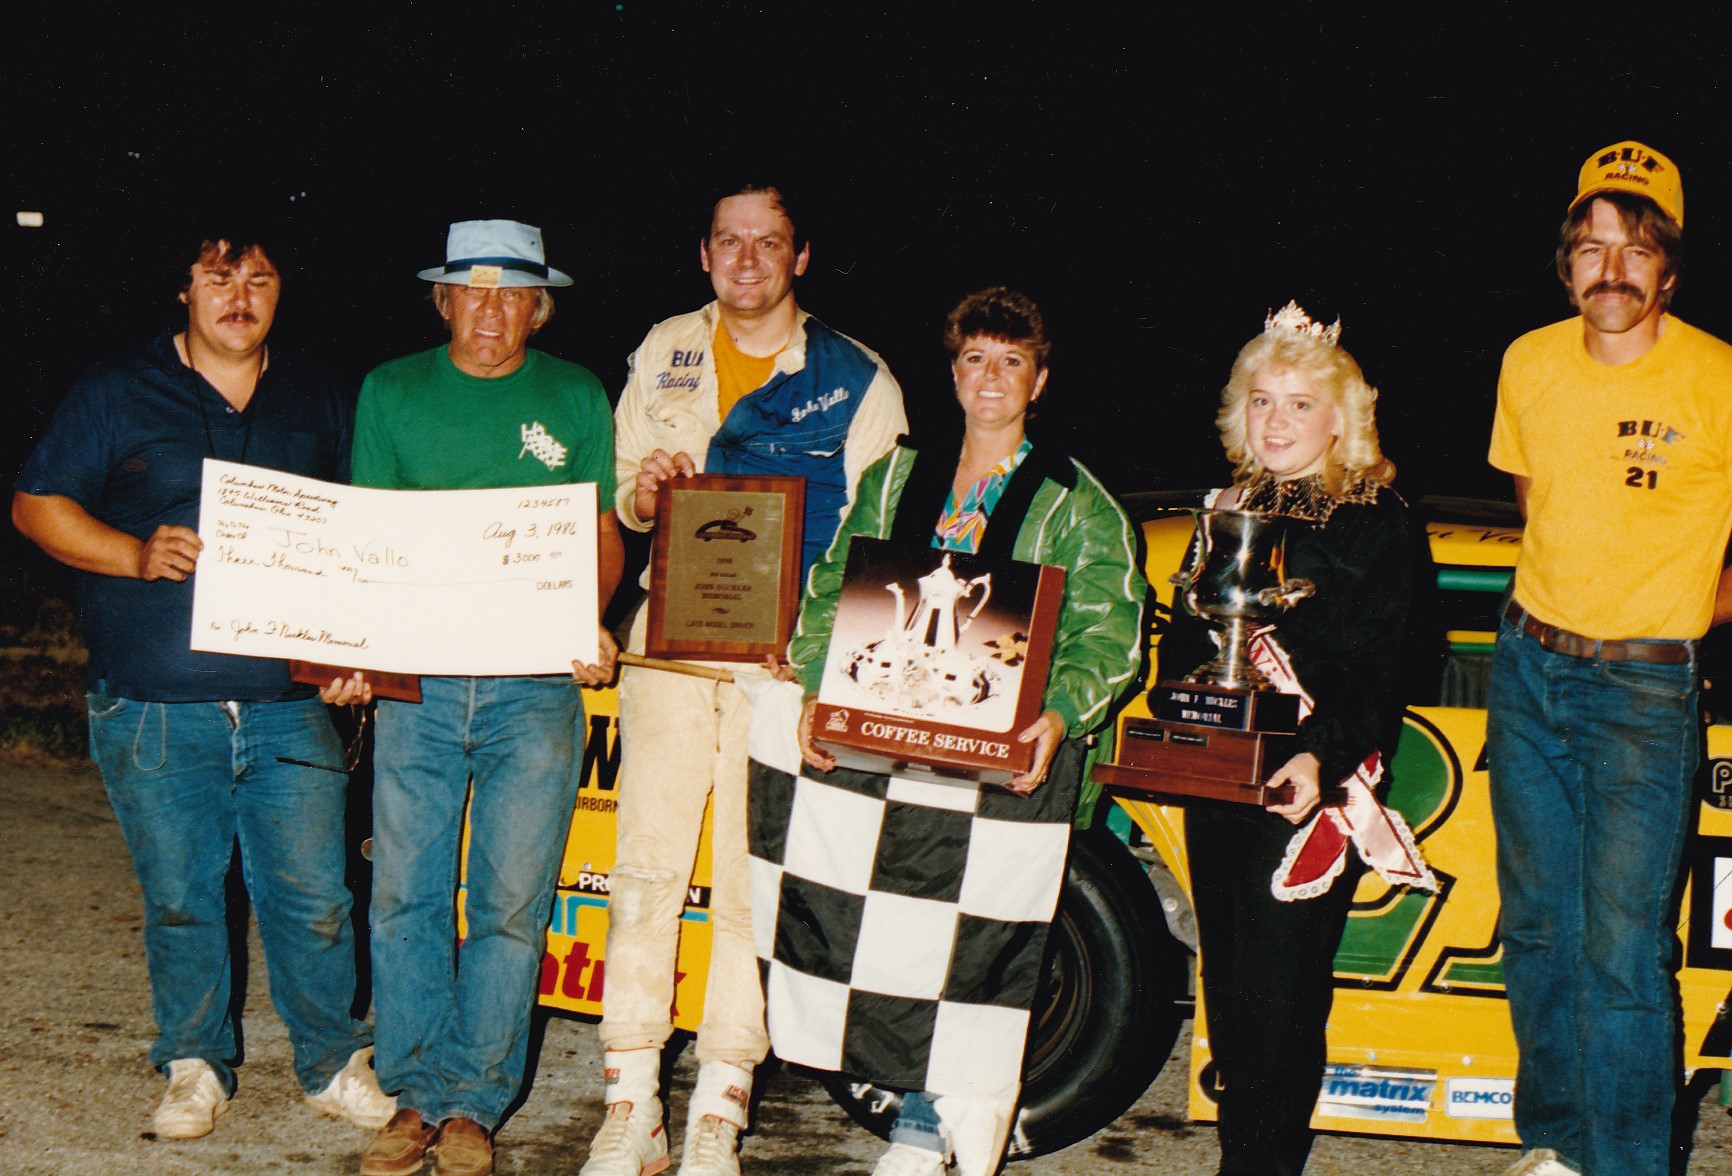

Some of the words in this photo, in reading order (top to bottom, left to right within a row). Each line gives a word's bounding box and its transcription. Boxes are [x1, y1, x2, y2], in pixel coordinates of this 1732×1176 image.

[1604, 172, 1650, 186] RACING
[656, 371, 702, 393] Racing
[1624, 448, 1667, 464] RACING
[1625, 466, 1658, 490] 21
[219, 474, 265, 489] Columbus
[266, 483, 292, 497] Motor
[293, 488, 338, 509] Speedway
[218, 495, 267, 511] Columbus
[270, 504, 292, 517] Ohio
[482, 521, 516, 548] Aug
[546, 521, 577, 537] 1986
[267, 526, 340, 559] John
[352, 539, 410, 568] Vallo
[211, 545, 259, 566] Three
[262, 551, 328, 577] Thousand
[536, 579, 573, 591] DOLLARS
[230, 618, 258, 641] John
[317, 629, 369, 650] Memorial
[860, 720, 932, 746] COFFEE
[932, 733, 1011, 760] SERVICE
[1327, 1078, 1429, 1102] matrix
[1451, 1090, 1513, 1105] BEMCO
[1373, 1104, 1426, 1115] system
